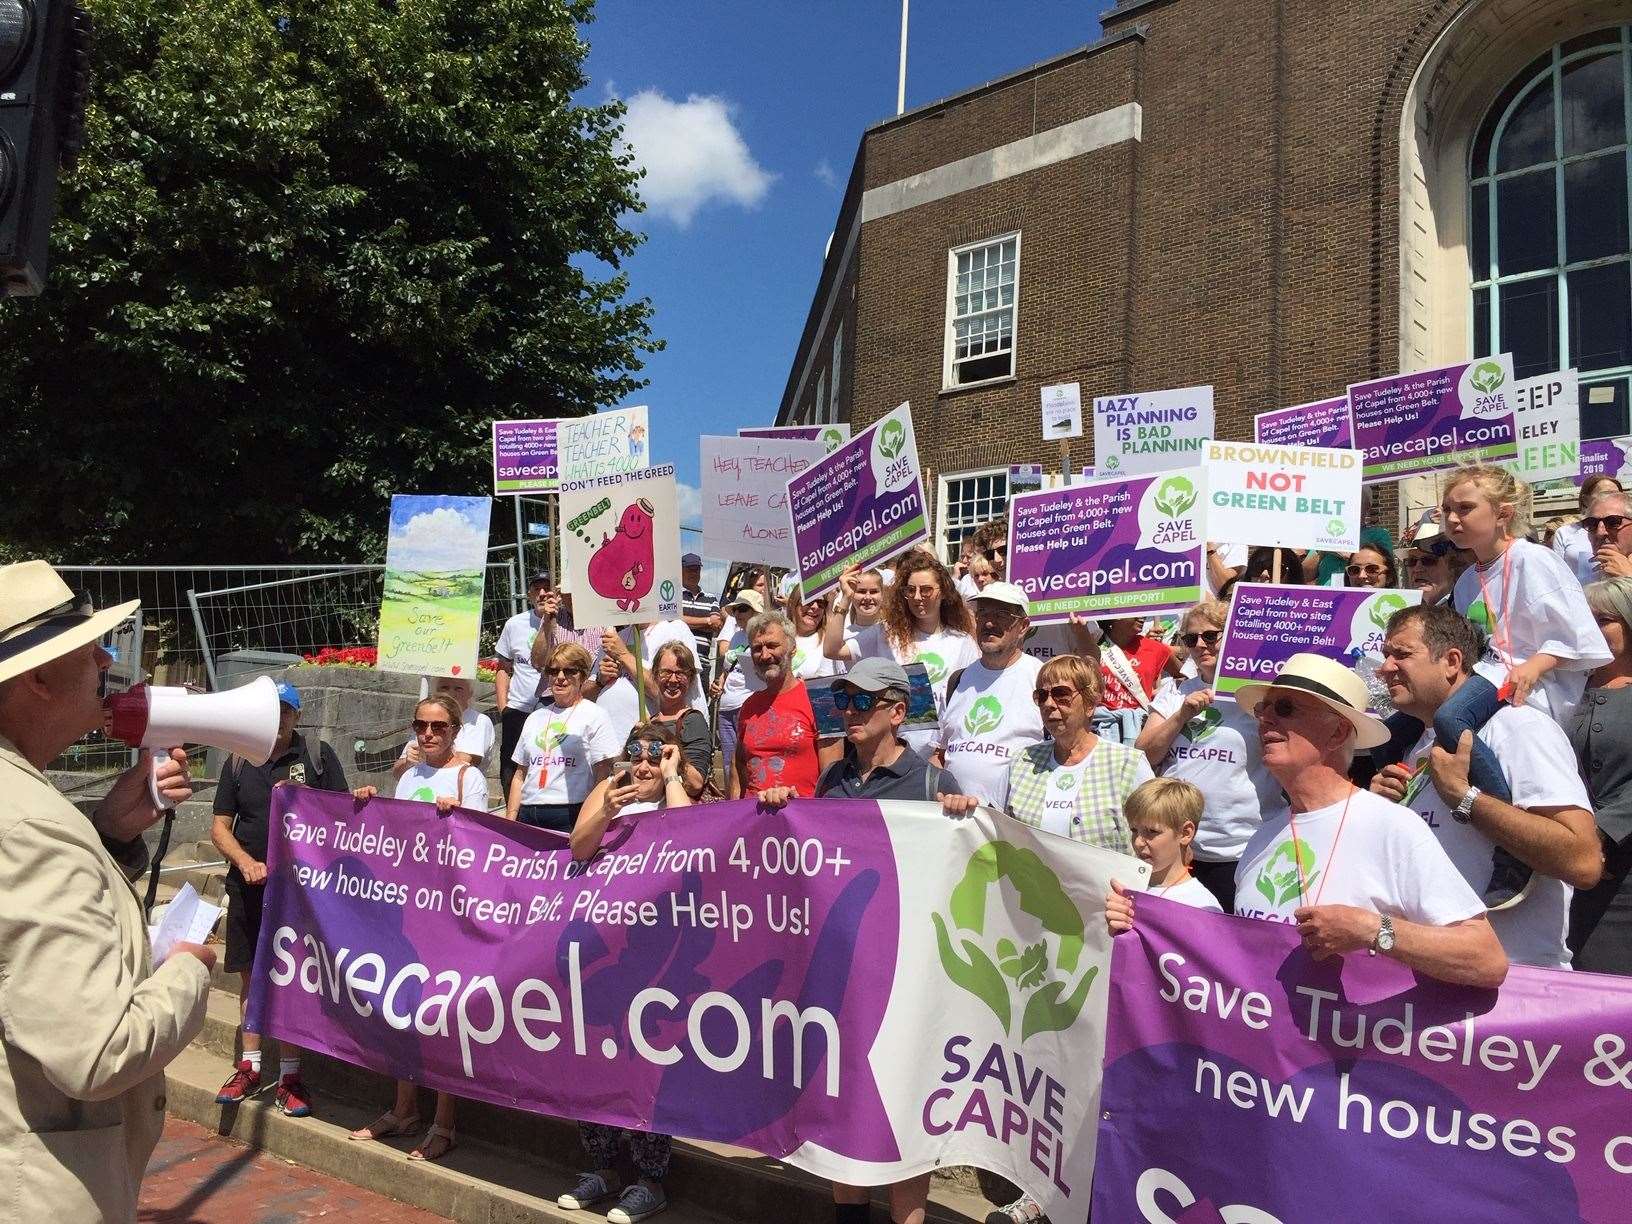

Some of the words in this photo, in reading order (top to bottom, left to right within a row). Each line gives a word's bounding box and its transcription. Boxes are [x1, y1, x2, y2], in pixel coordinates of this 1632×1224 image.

[1355, 393, 1371, 401] Save
[1373, 386, 1402, 396] Tudeley
[1412, 381, 1424, 390] the
[1426, 377, 1450, 387] Parish
[1364, 398, 1386, 409] Capel
[1387, 395, 1405, 404] from
[1408, 390, 1434, 400] 4,000+
[1517, 382, 1563, 412] EEP
[1098, 396, 1139, 414] LAZY
[1356, 410, 1382, 419] houses
[1395, 402, 1419, 411] Green
[1422, 398, 1439, 407] Belt.
[1473, 403, 1508, 415] CAPEL
[1476, 394, 1504, 406] SAVE
[1107, 406, 1198, 427] PLANNING
[1261, 421, 1278, 430] Save
[1279, 415, 1306, 426] Tudeley
[1315, 409, 1327, 417] the
[1357, 420, 1382, 430] Please
[1384, 416, 1404, 425] Help
[1405, 412, 1418, 421] Us!
[566, 416, 626, 444] TEACHER
[1117, 427, 1131, 441] IS
[1137, 425, 1171, 440] BAD
[1270, 426, 1290, 436] Capel
[1292, 422, 1308, 431] from
[1298, 429, 1321, 438] Green
[564, 436, 621, 463] TEACHER
[1362, 424, 1511, 460] savecapel.com
[886, 455, 909, 477] SAVE
[1209, 445, 1355, 469] BROWNFIELD
[1398, 460, 1420, 469] NEED
[1422, 456, 1445, 466] YOUR
[562, 479, 594, 492] DON'T
[598, 474, 622, 486] FEED
[625, 470, 643, 482] THE
[645, 466, 674, 478] GREED
[792, 487, 806, 500] Save
[806, 471, 828, 490] Tudeley
[829, 466, 834, 476] &
[834, 461, 845, 472] the
[845, 448, 864, 465] Parish
[884, 466, 913, 488] CAPEL
[1583, 464, 1604, 474] 2019
[801, 488, 818, 507] Capel
[818, 482, 832, 495] from
[832, 468, 853, 486] 4,000+
[854, 460, 867, 472] new
[1246, 471, 1306, 493] NOT
[718, 493, 759, 507] LEAVE
[768, 493, 789, 510] CA
[795, 506, 816, 521] houses
[824, 487, 844, 502] Green
[844, 478, 859, 491] Belt.
[1017, 506, 1039, 517] Save
[1040, 501, 1073, 514] Tudeley
[1075, 499, 1083, 508] &
[1085, 496, 1100, 507] the
[1102, 491, 1131, 504] Parish
[1212, 491, 1286, 511] GREEN
[1296, 498, 1345, 515] BELT
[567, 497, 611, 531] GREENBELT
[797, 516, 817, 534] Please
[817, 507, 832, 522] Help
[833, 500, 844, 512] Us!
[1017, 517, 1027, 528] of
[1028, 516, 1053, 529] Capel
[1054, 512, 1076, 524] from
[1078, 508, 1109, 520] 4,000+
[1111, 505, 1133, 515] new
[743, 523, 788, 539] ALONE
[802, 493, 918, 571] savecapel.com
[1016, 528, 1046, 540] houses
[1049, 527, 1060, 537] on
[1062, 522, 1090, 534] Green
[1093, 519, 1115, 530] Belt.
[1157, 519, 1193, 532] SAVE
[869, 529, 903, 556] SUPPORT!
[1016, 543, 1044, 554] Please
[1046, 539, 1069, 551] Help
[1071, 537, 1087, 546] Us!
[1152, 531, 1197, 544] CAPEL
[659, 603, 677, 611] EARTH
[1036, 603, 1051, 613] WE
[1054, 600, 1080, 611] NEED
[1084, 597, 1112, 609] YOUR
[1113, 592, 1165, 606] SUPPORT!
[1240, 595, 1262, 605] Save
[1264, 596, 1300, 609] Tudeley
[1301, 597, 1311, 608] &
[1312, 599, 1333, 609] East
[408, 607, 445, 625] Save
[1237, 606, 1264, 620] Capel
[1266, 608, 1287, 619] from
[1290, 610, 1308, 620] two
[1309, 610, 1332, 621] sites
[415, 627, 437, 635] our
[1235, 618, 1271, 631] totalling
[1273, 621, 1304, 632] 4000+
[1304, 624, 1326, 633] new
[1232, 629, 1264, 641] houses
[1266, 633, 1278, 641] on
[1281, 633, 1311, 645] Green
[1046, 801, 1073, 809] VECA
[282, 812, 327, 848] Save
[333, 820, 407, 867] Tudeley
[412, 831, 429, 863] &
[437, 834, 476, 869] the
[482, 843, 558, 881] Parish
[652, 839, 716, 874] from
[728, 836, 852, 880] 4,000+
[335, 863, 409, 906] houses
[414, 886, 444, 911] on
[449, 884, 522, 925] Green
[525, 890, 563, 925] Belt.
[569, 889, 658, 926] Please
[671, 890, 754, 943] Help
[767, 894, 811, 936] Us!
[268, 926, 841, 1098] savecapel.com
[1158, 952, 1273, 1031] Save
[1295, 985, 1562, 1092] Tudeley
[1582, 1033, 1632, 1088] &
[941, 1034, 1067, 1136] SAVE
[1195, 1057, 1315, 1124] new
[1338, 1073, 1577, 1164] houses
[1604, 1133, 1632, 1174] o
[921, 1087, 1072, 1199] CAPEL
